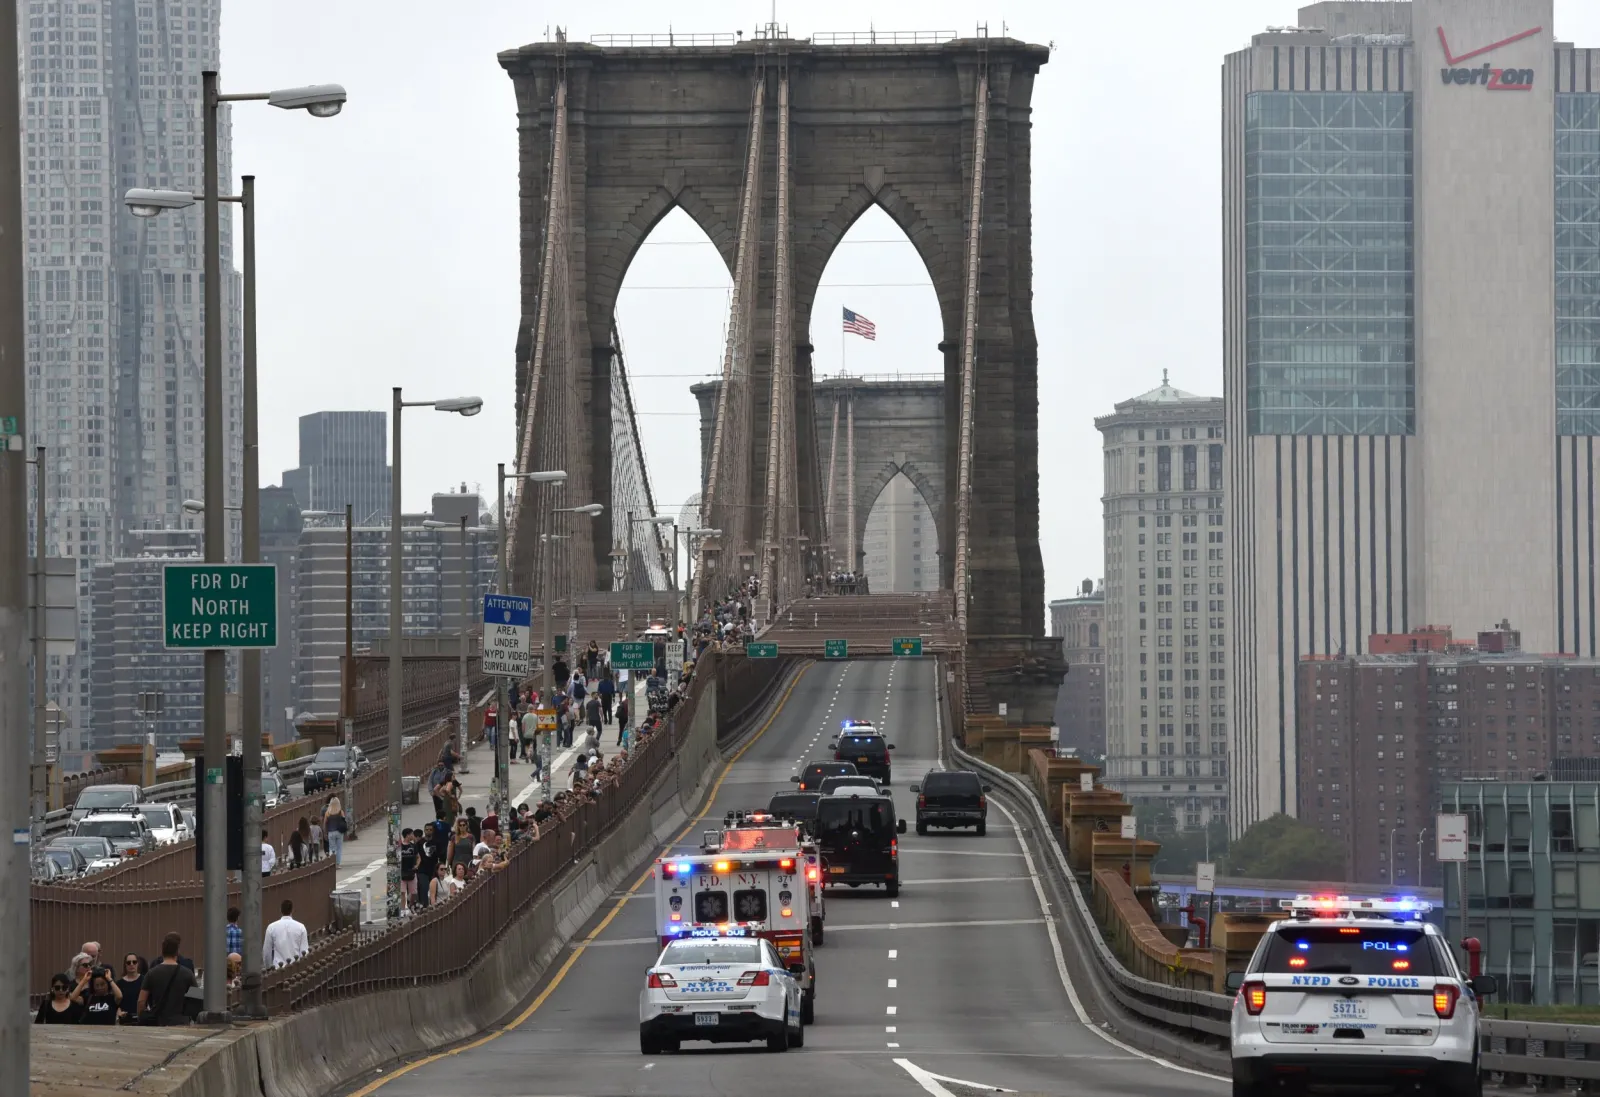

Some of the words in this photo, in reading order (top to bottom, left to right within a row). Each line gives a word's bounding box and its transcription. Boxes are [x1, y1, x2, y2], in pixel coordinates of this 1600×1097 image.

[1440, 63, 1534, 91] verizon
[191, 573, 222, 589] FDR
[230, 573, 248, 589] Dr
[191, 597, 249, 616] NORTH
[487, 598, 529, 611] ATTENTION
[172, 623, 212, 639] KEEP
[220, 622, 268, 638] RIGHT
[496, 625, 517, 636] AREA
[494, 637, 519, 648] UNDER
[667, 644, 682, 652] KEEP
[484, 649, 505, 660] NYPD
[507, 650, 528, 661] VIDEO
[622, 652, 643, 660] NORTH
[484, 660, 527, 674] SURVEILLANCE
[611, 660, 629, 668] RIGHT
[777, 875, 793, 884] 371
[1292, 975, 1331, 986] NYPD
[1367, 976, 1420, 988] POLICE
[1333, 1003, 1357, 1014] 5571
